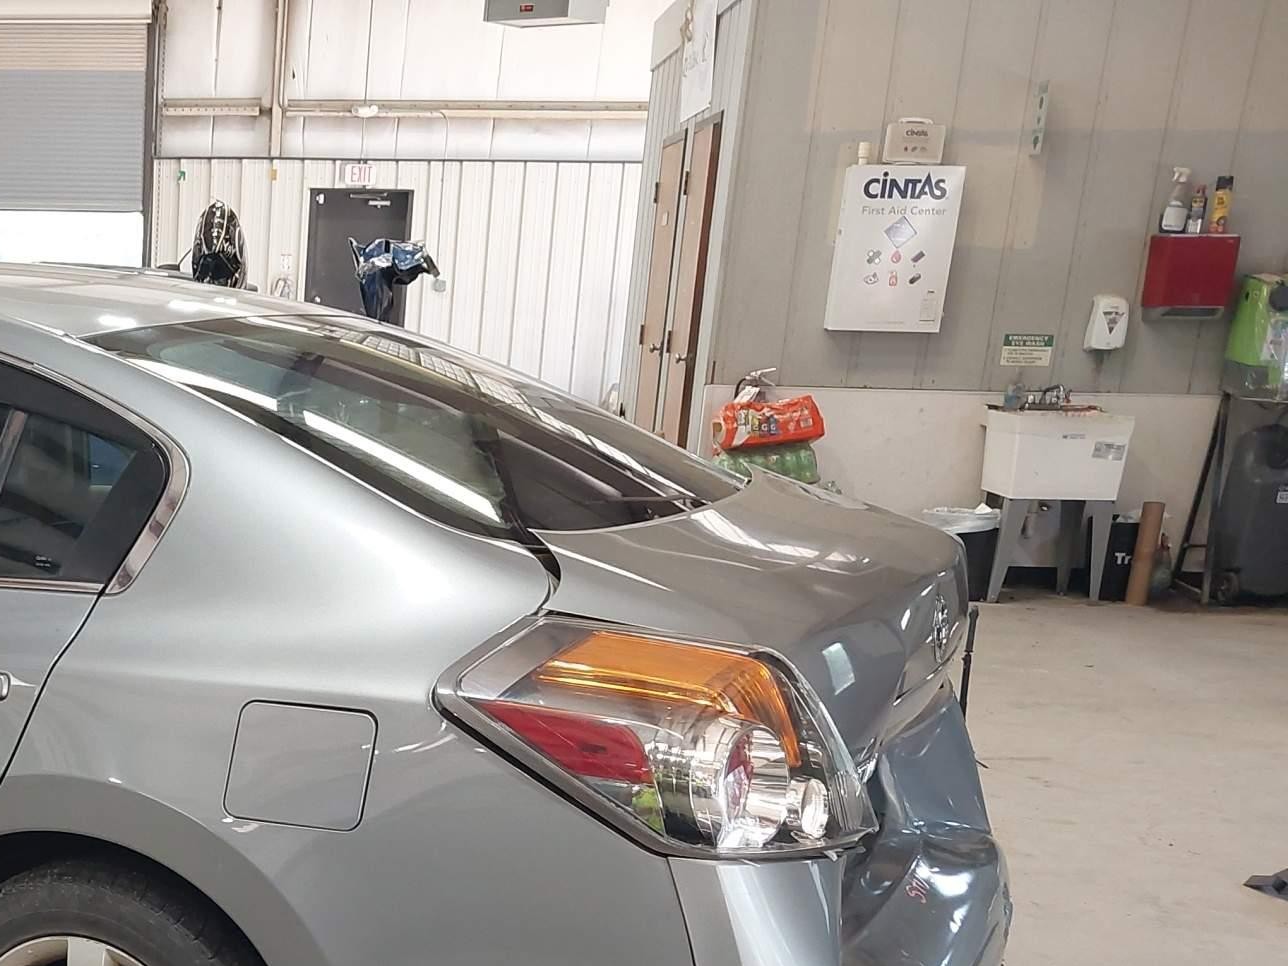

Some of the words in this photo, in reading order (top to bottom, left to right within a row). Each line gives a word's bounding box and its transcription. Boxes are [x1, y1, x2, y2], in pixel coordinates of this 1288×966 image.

[350, 165, 373, 183] EXIT
[862, 206, 885, 216] First
[888, 206, 907, 215] Aid
[910, 206, 947, 216] Center
